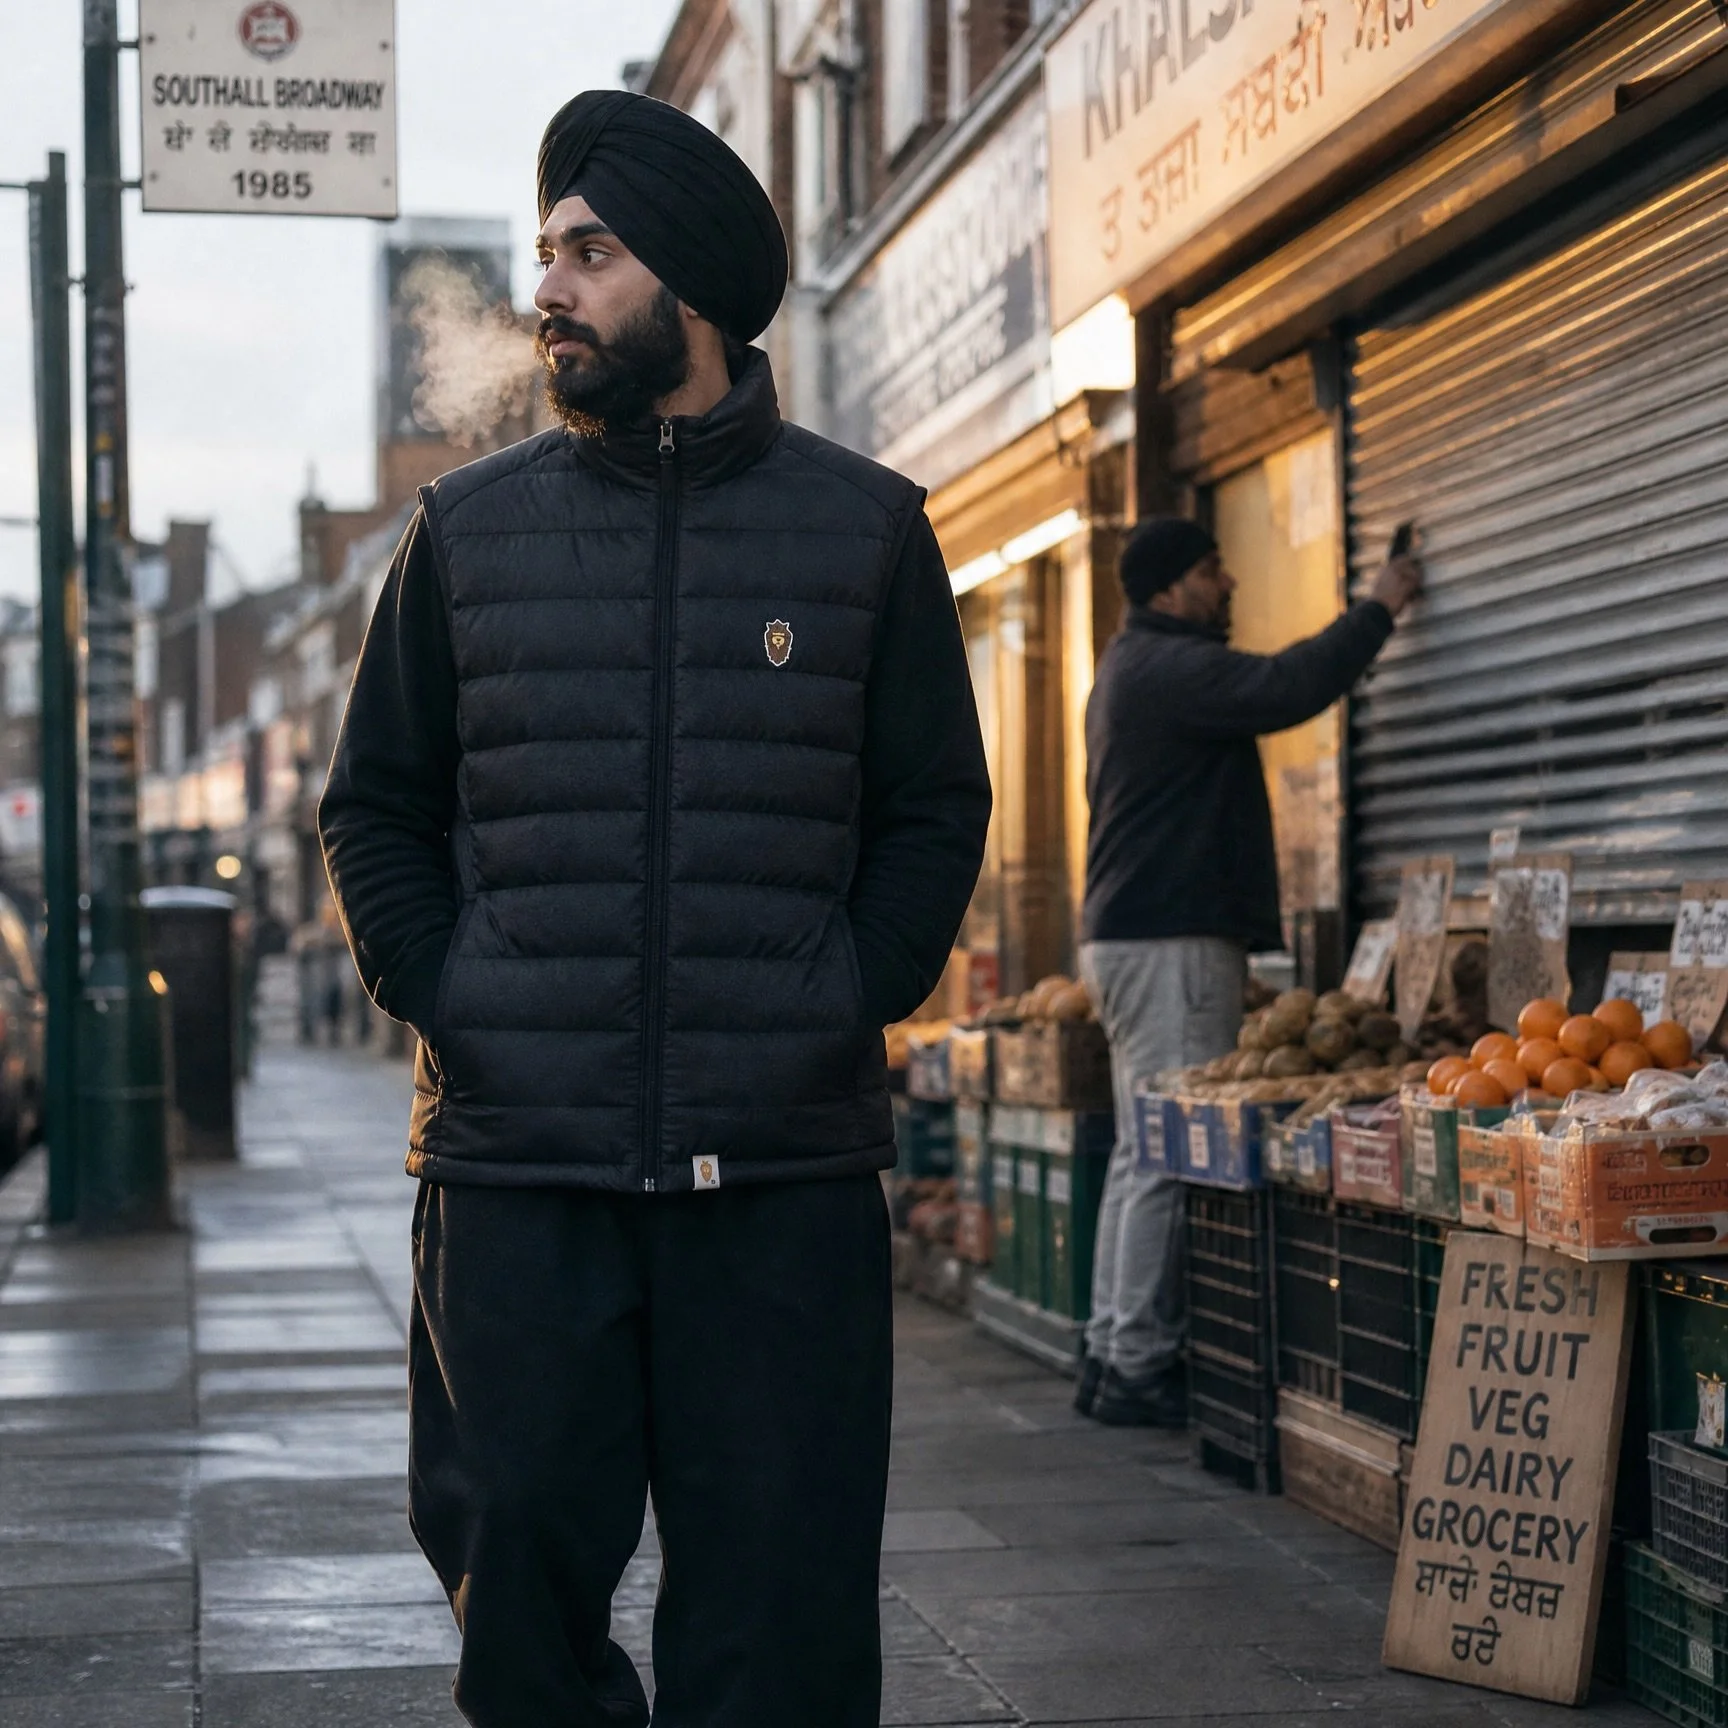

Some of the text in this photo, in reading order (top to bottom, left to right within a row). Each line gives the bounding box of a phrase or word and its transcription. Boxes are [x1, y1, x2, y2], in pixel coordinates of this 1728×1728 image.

[152, 74, 386, 110] SOUTHALL BROADWAY
[232, 169, 314, 199] 1985
[1461, 1262, 1600, 1317] FRESH
[1456, 1323, 1591, 1381] FRUIT
[1469, 1386, 1551, 1440] VEG
[1444, 1443, 1574, 1501] DAIRY
[1411, 1496, 1589, 1565] GROCERY
